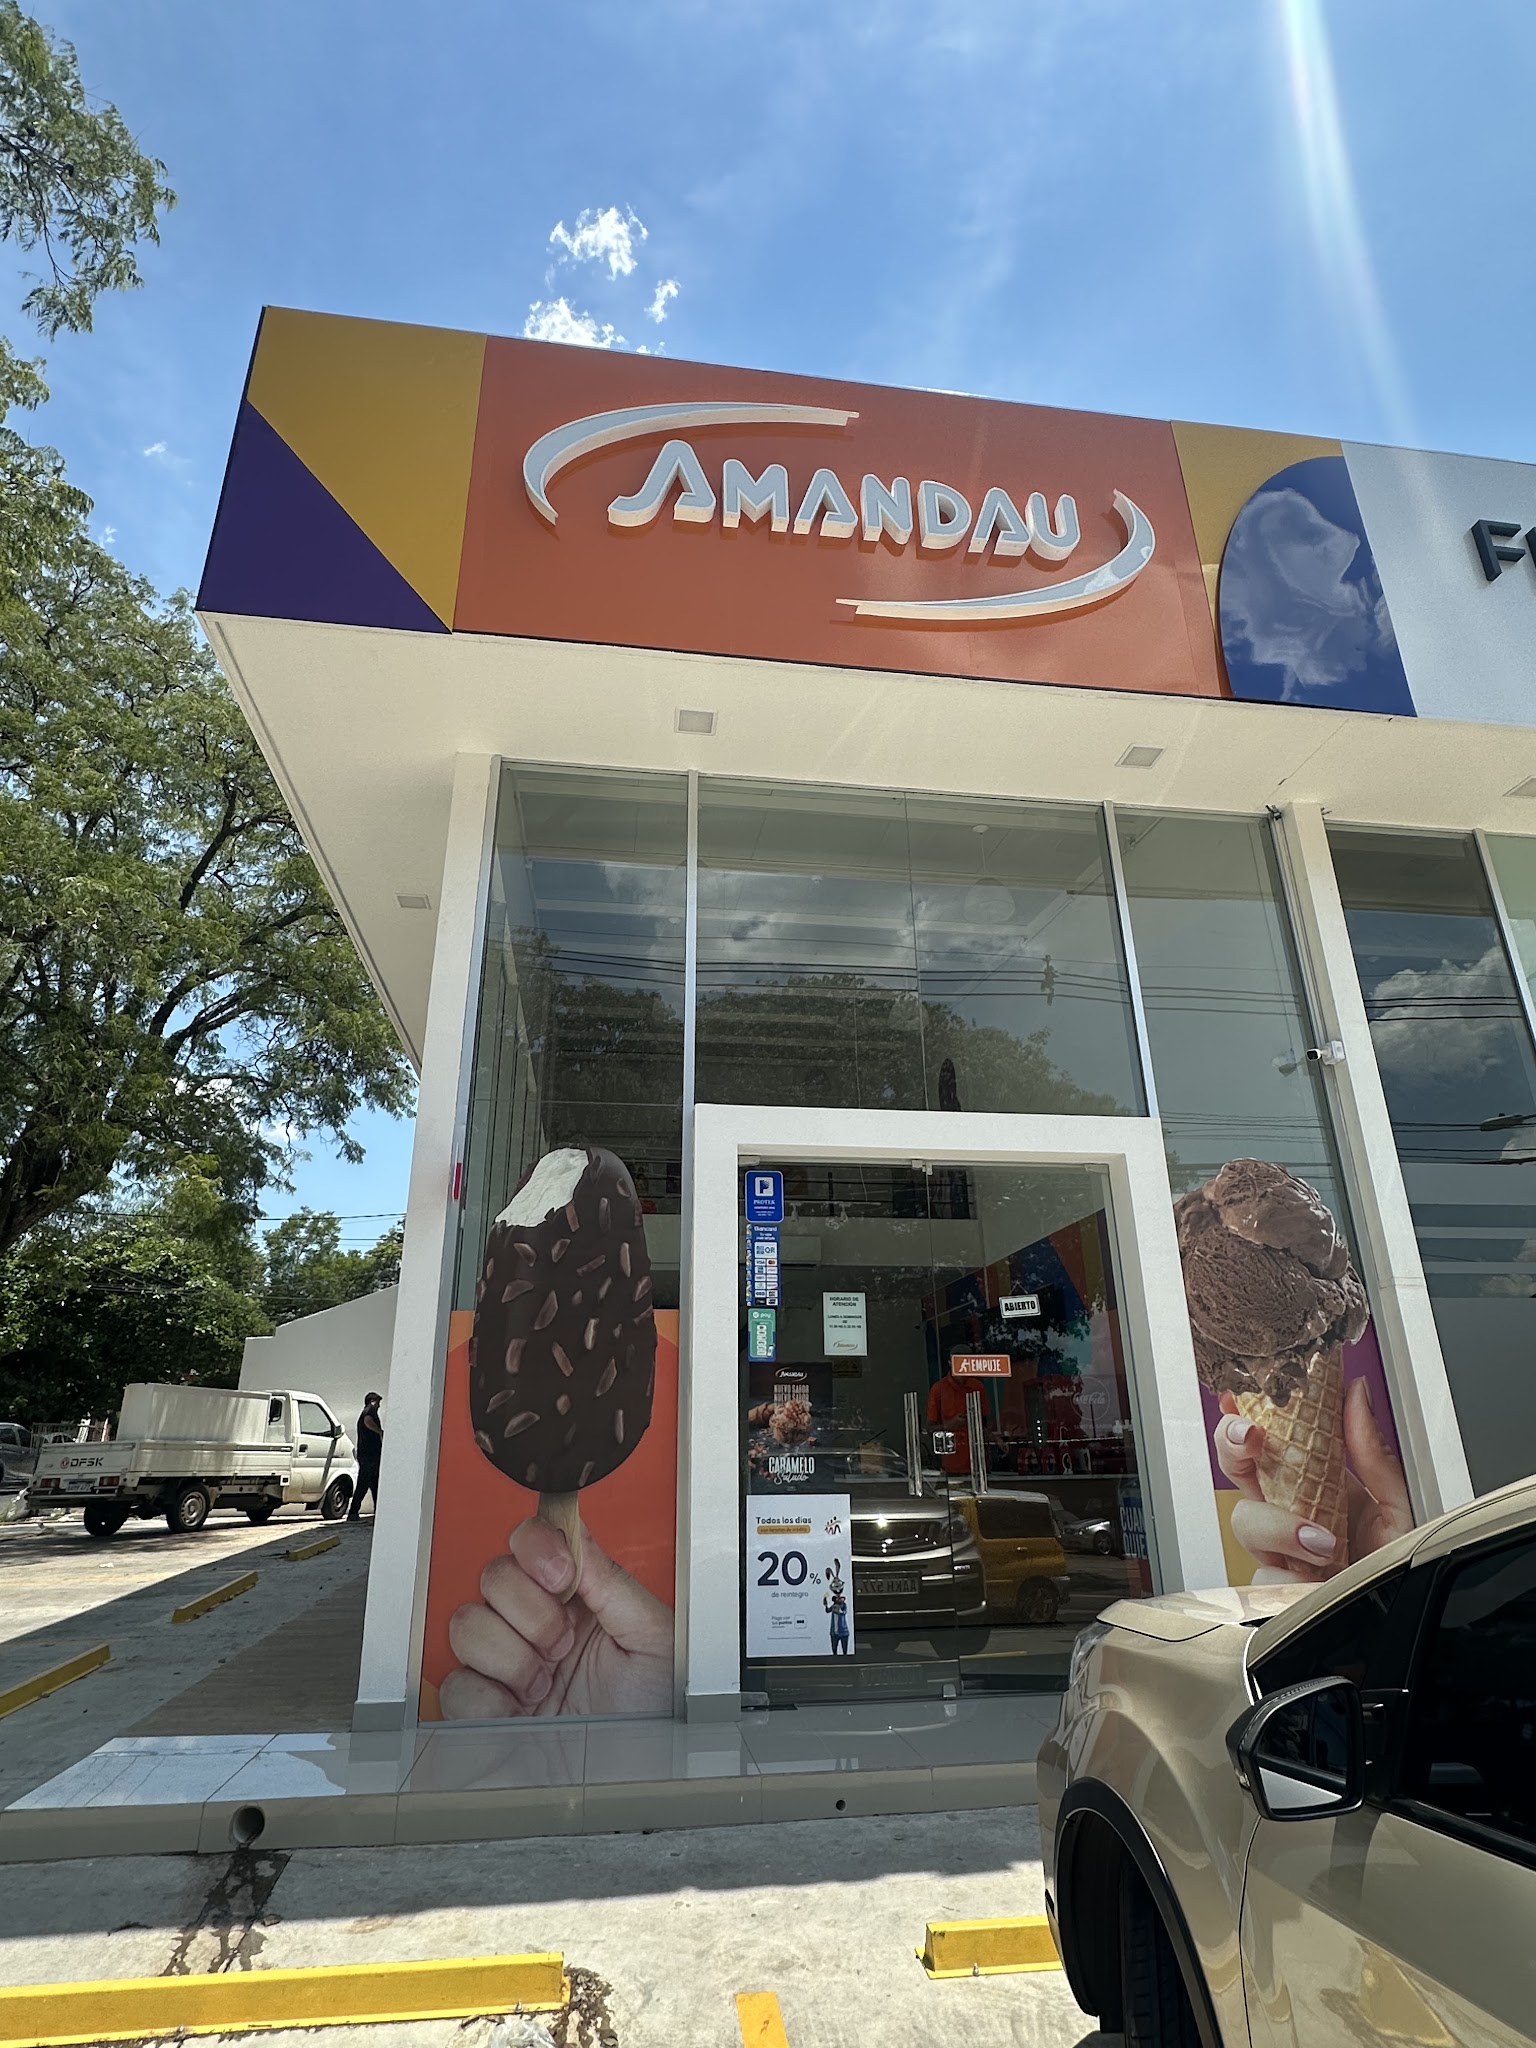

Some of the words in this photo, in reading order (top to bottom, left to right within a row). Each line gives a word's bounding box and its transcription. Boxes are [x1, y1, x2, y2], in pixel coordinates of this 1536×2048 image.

[606, 438, 1081, 562] AMANDAU
[764, 1246, 776, 1254] QR
[1004, 1300, 1036, 1312] ABIERTO
[970, 1358, 1002, 1372] EMPUJE
[773, 1384, 791, 1393] NUEVO
[791, 1384, 810, 1393] SABOR
[70, 1456, 104, 1467] DFSK
[768, 1456, 815, 1475] CARAMELO
[755, 1516, 781, 1525] Todos
[782, 1516, 793, 1524] los
[780, 1591, 809, 1599] reintegro
